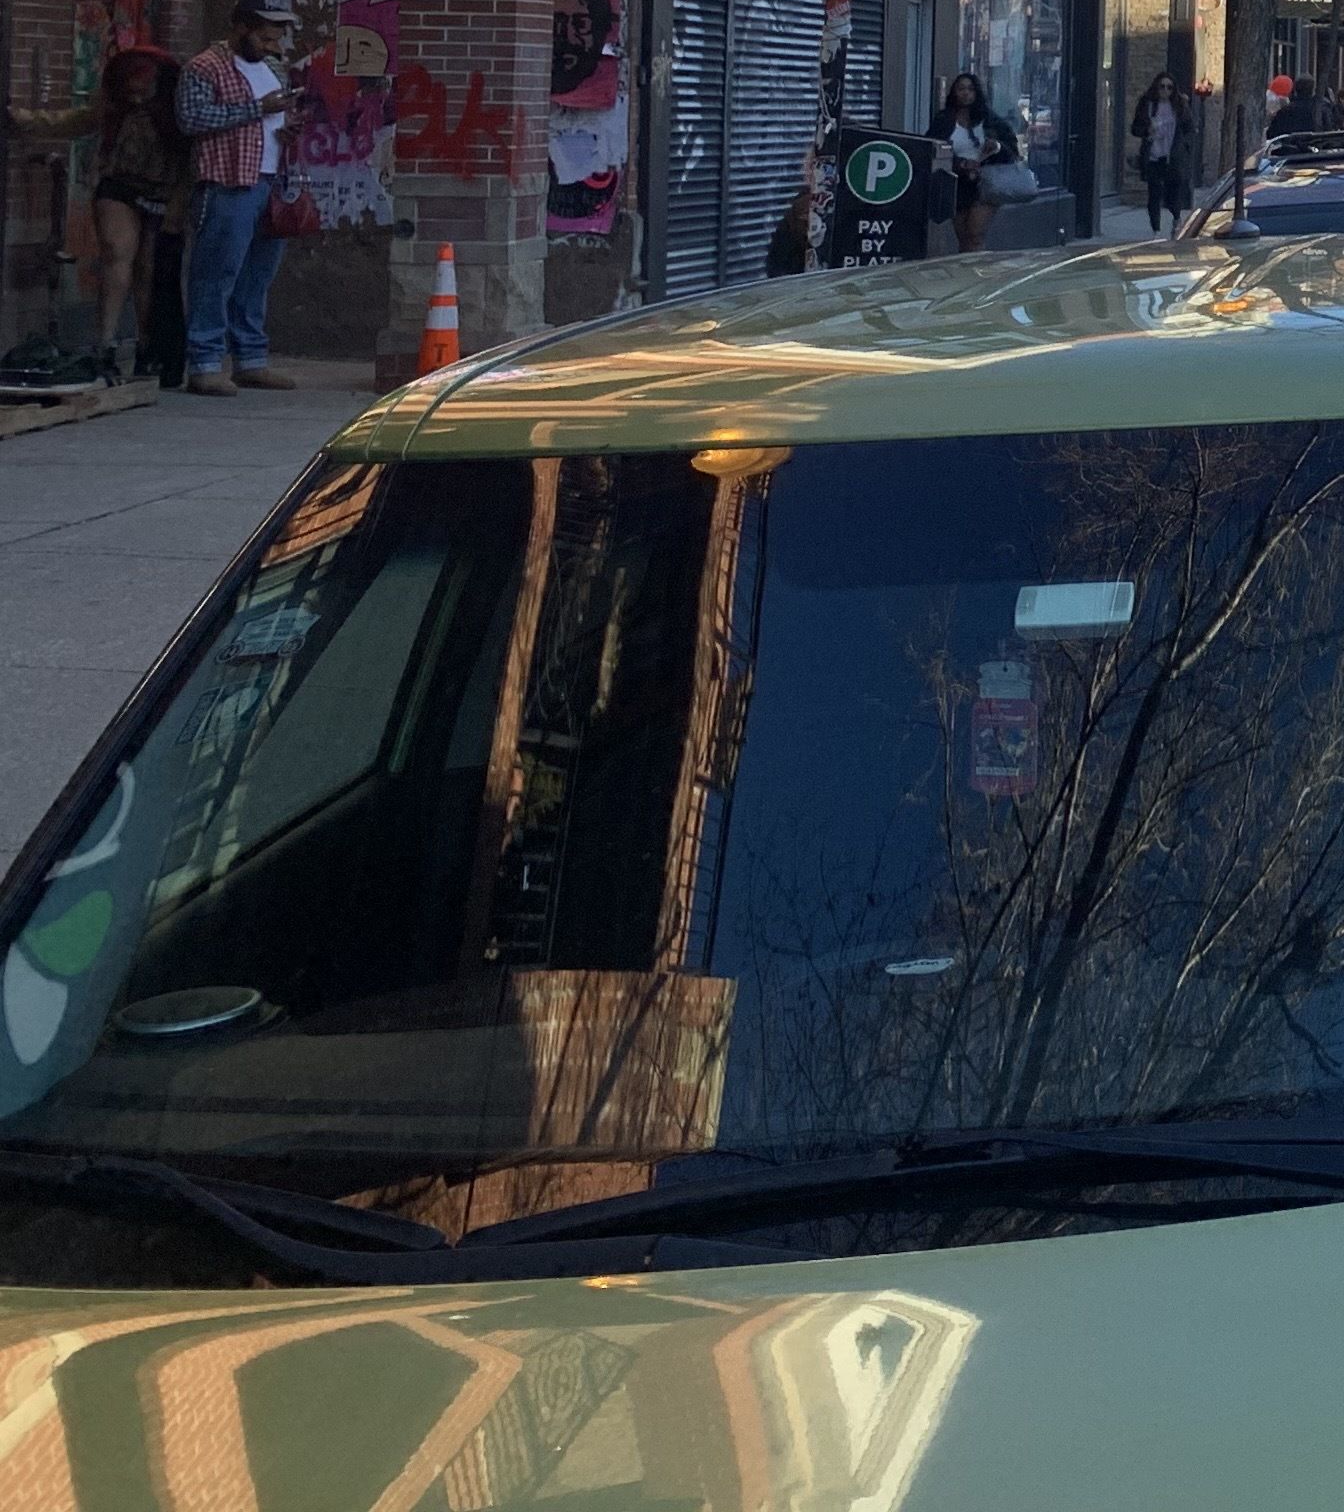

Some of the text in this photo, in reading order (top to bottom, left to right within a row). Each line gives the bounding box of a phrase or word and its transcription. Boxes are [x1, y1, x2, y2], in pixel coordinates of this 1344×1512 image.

[865, 151, 897, 192] P
[858, 220, 894, 234] PAY
[861, 238, 885, 252] BY
